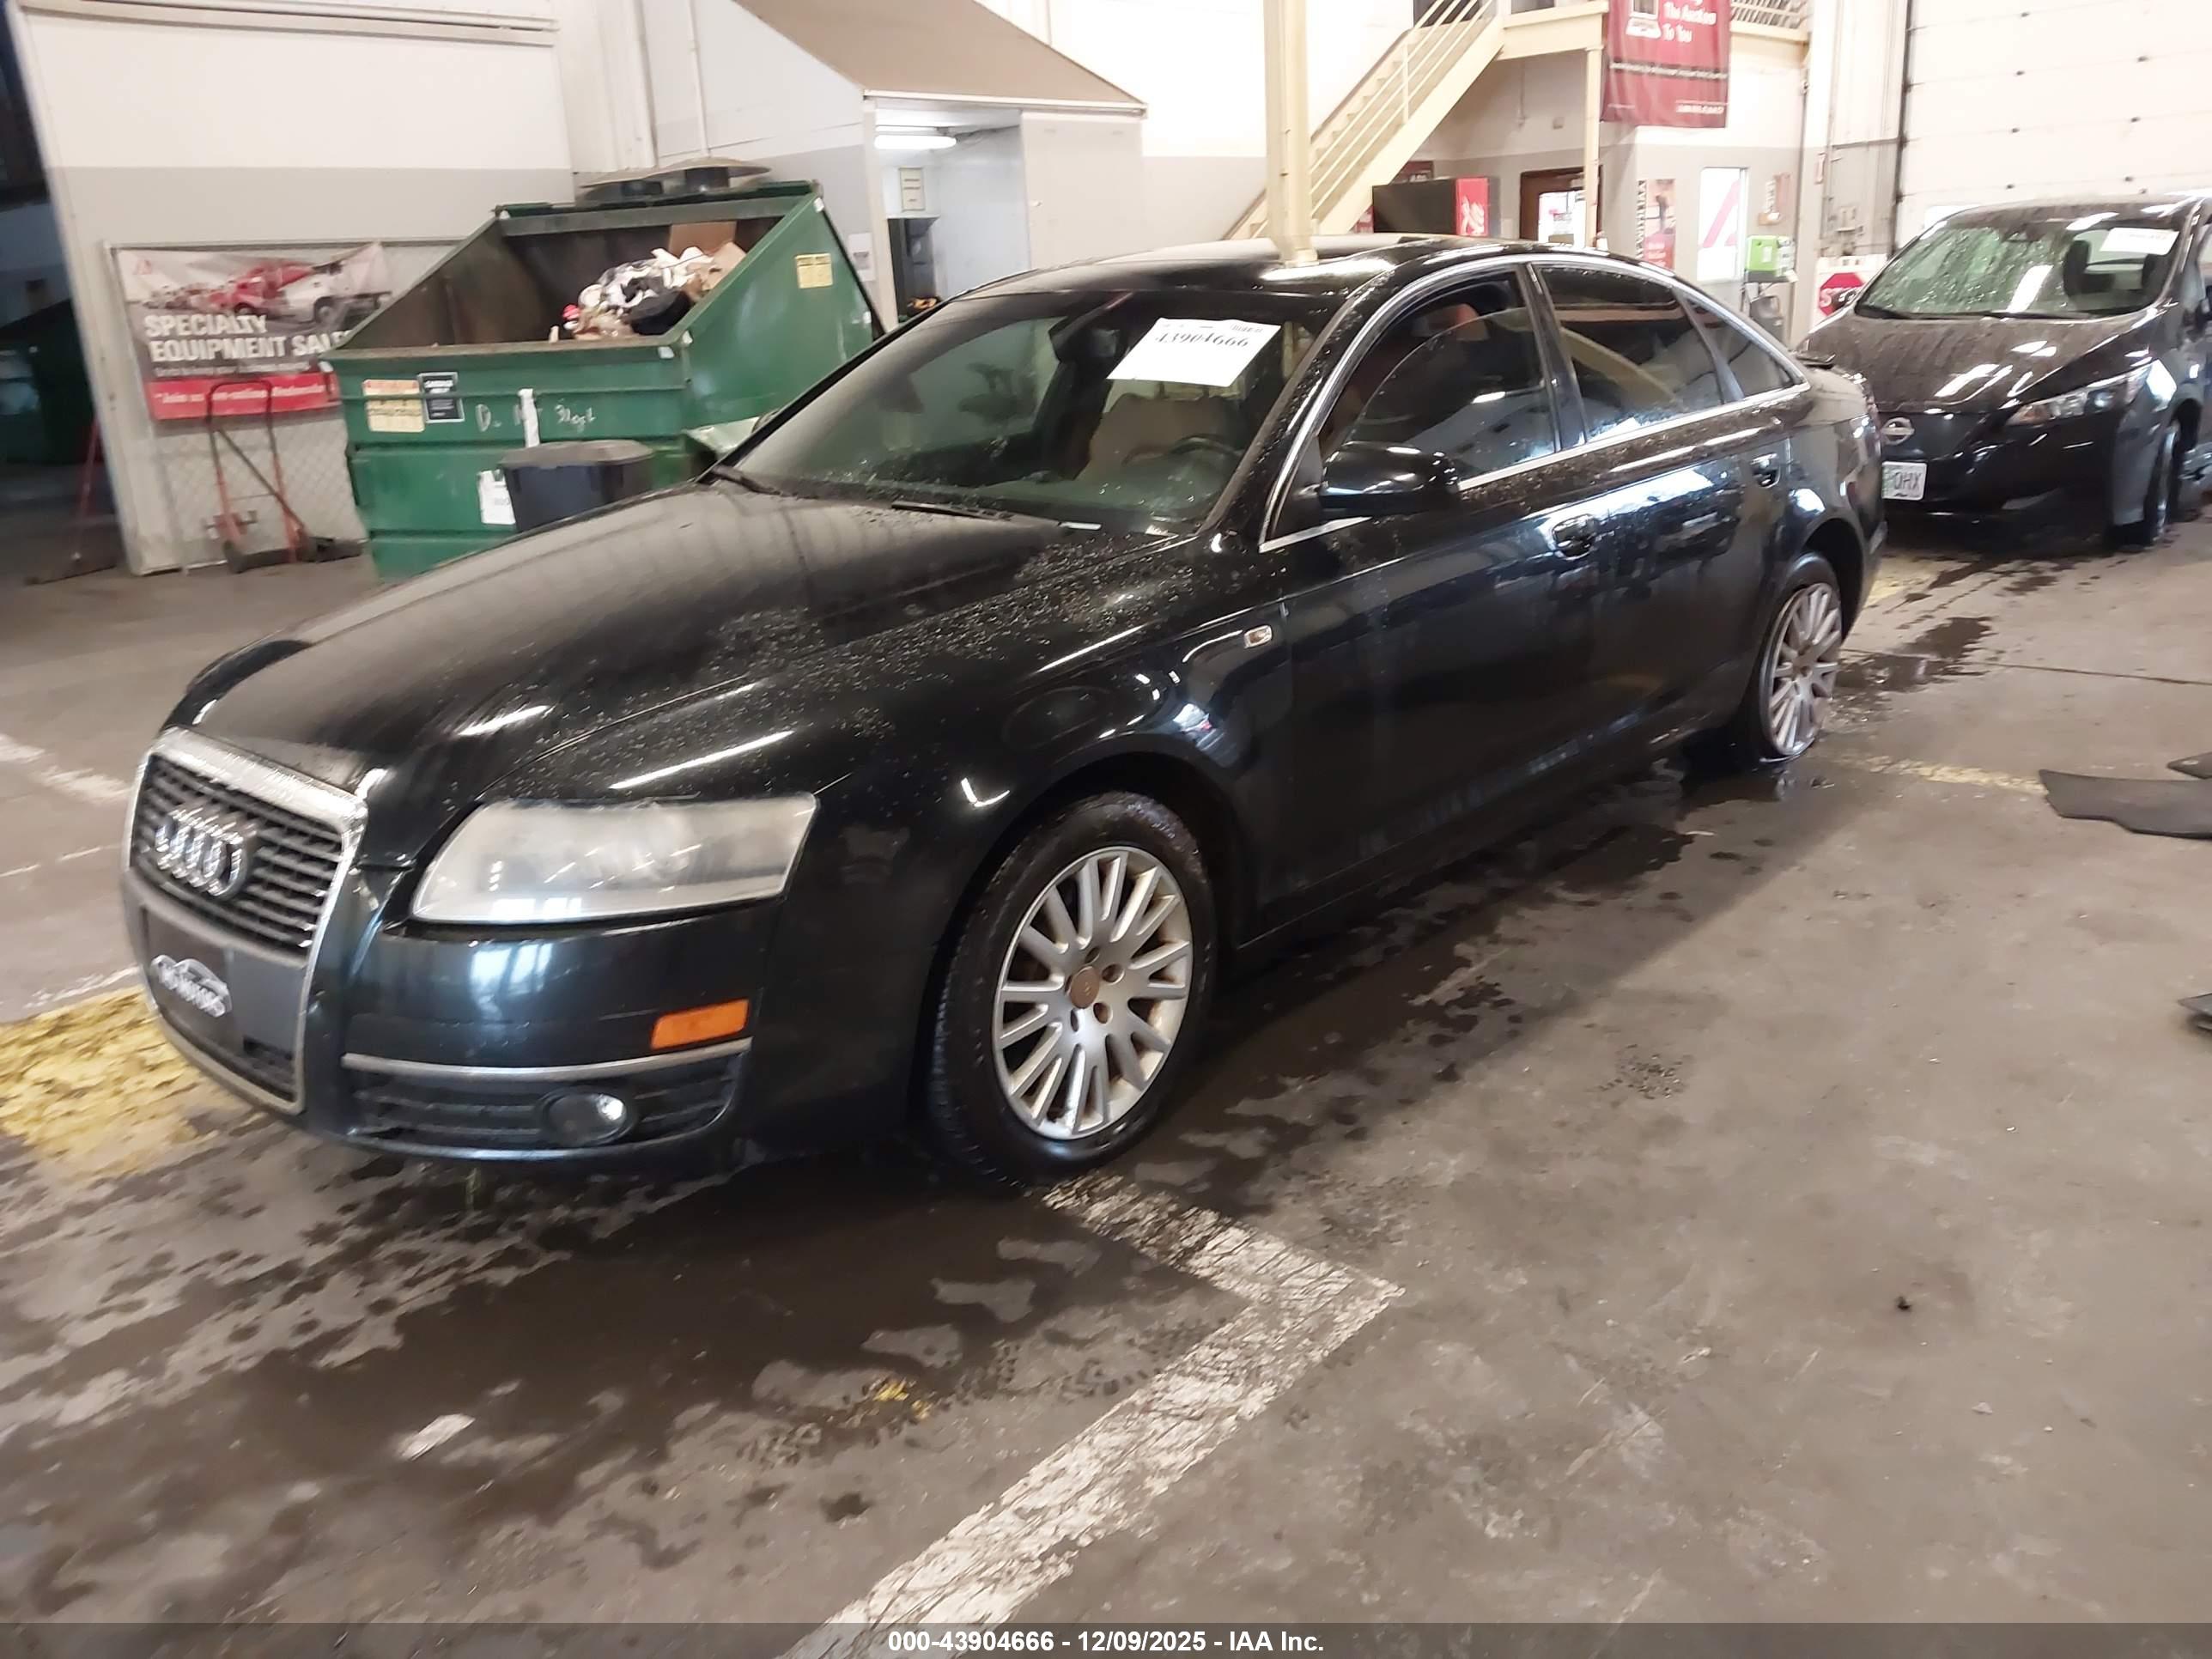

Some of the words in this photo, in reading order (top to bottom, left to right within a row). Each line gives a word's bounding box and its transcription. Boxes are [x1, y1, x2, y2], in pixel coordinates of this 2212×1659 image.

[144, 313, 268, 338] SPECIALTY
[149, 335, 287, 362] EQUIPMENT
[1155, 331, 1249, 348] 43904666
